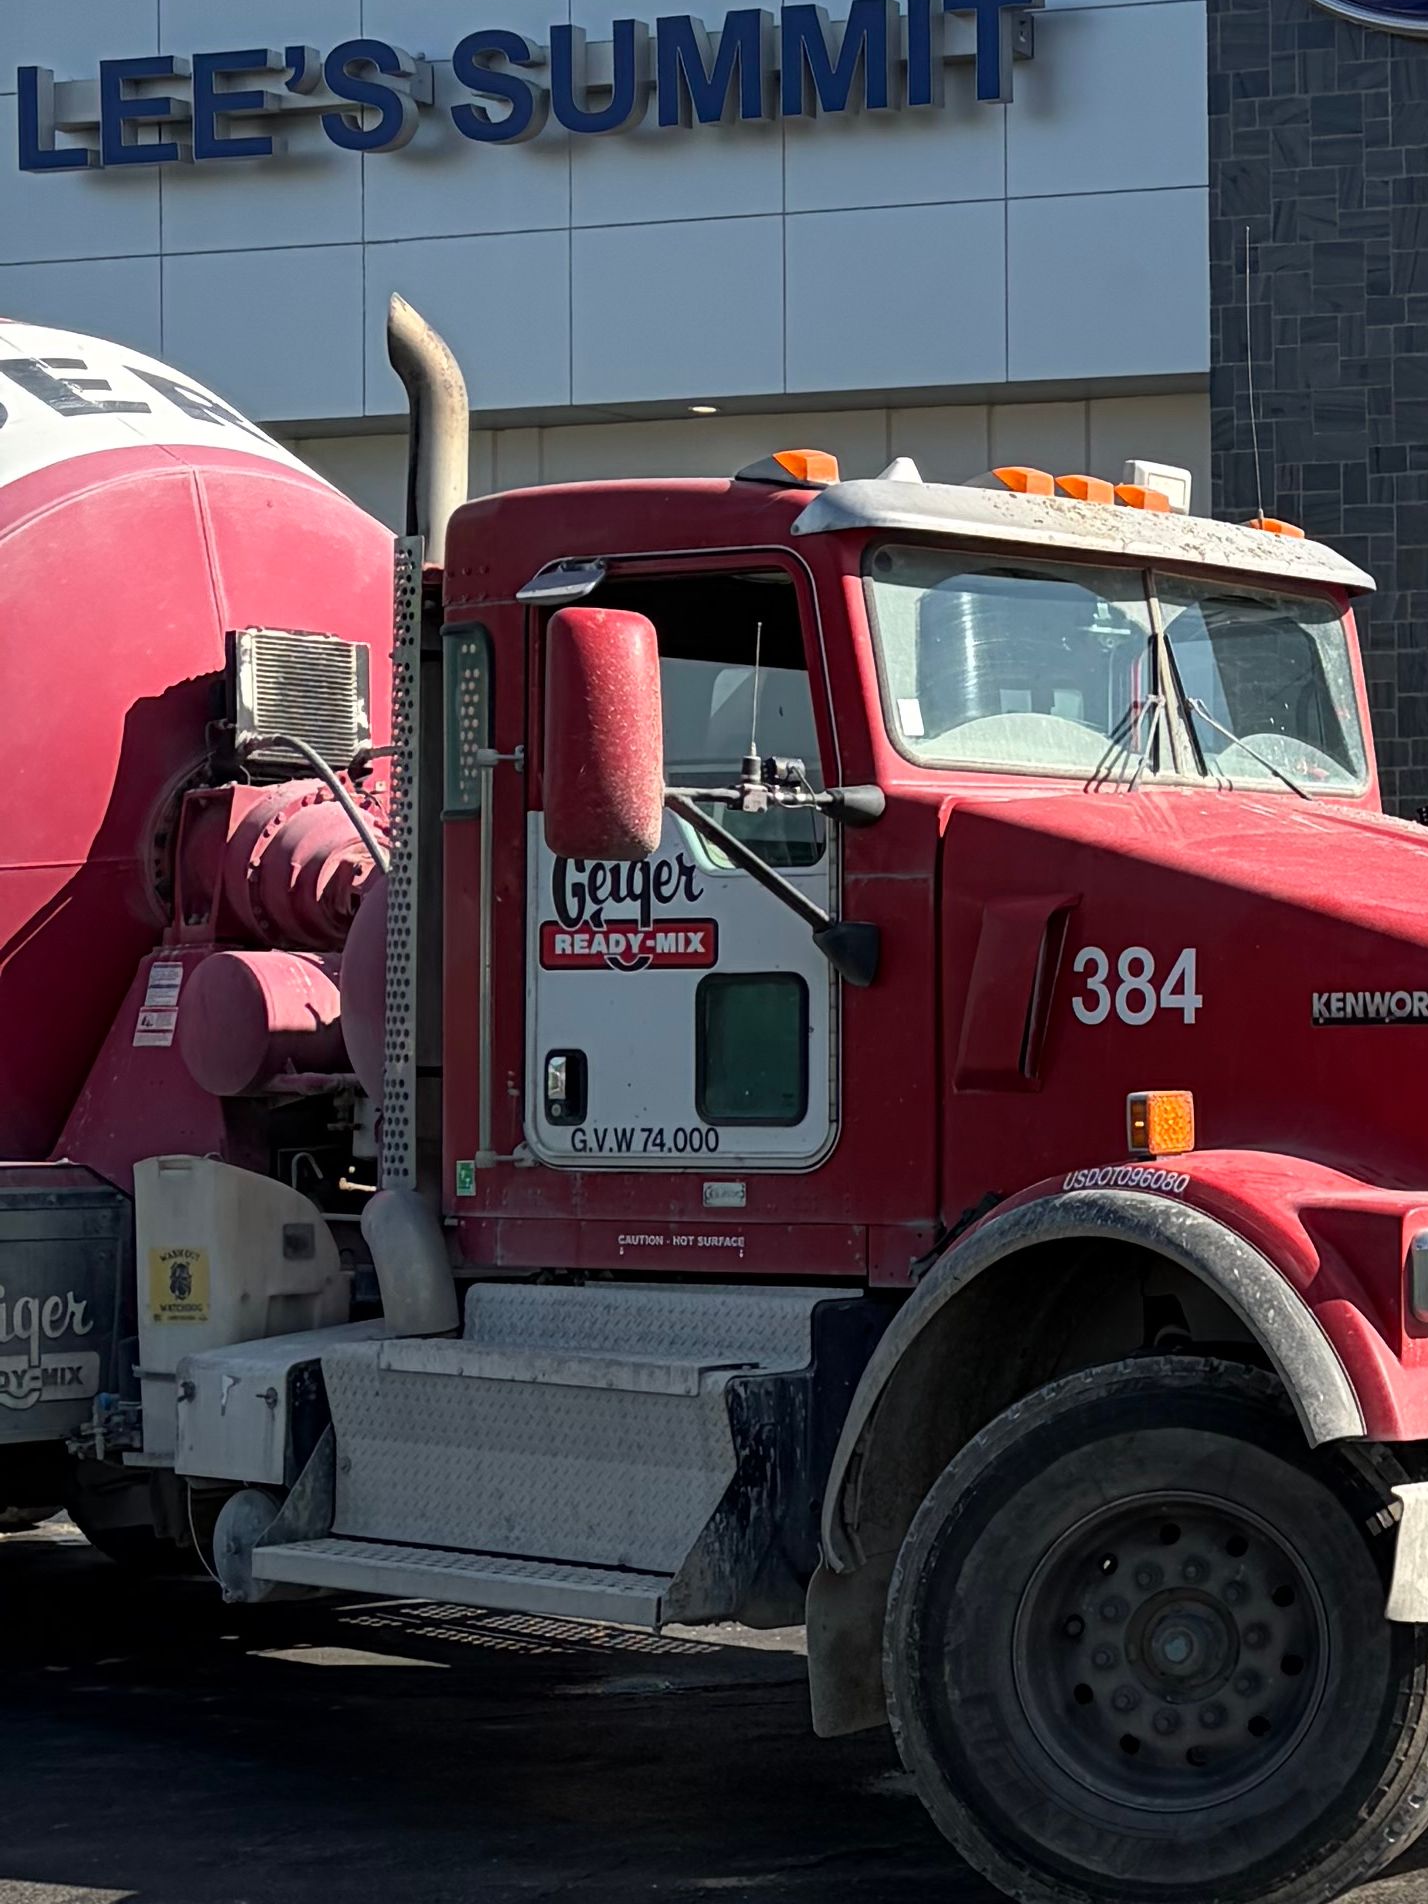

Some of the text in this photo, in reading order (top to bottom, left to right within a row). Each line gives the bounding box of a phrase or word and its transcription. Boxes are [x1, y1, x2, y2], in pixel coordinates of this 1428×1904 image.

[17, 38, 414, 172] LEE'S
[0, 358, 278, 448] ER
[552, 852, 704, 932] Geiger
[554, 932, 705, 955] READY-MIX
[1072, 946, 1203, 1025] 384
[571, 1127, 720, 1153] G.V.W 74.000
[1062, 1166, 1191, 1193] USDOT096080
[618, 1234, 664, 1246] CAUTION
[672, 1235, 694, 1246] HOT
[697, 1236, 745, 1247] SURFACE
[0, 1284, 94, 1367] iger
